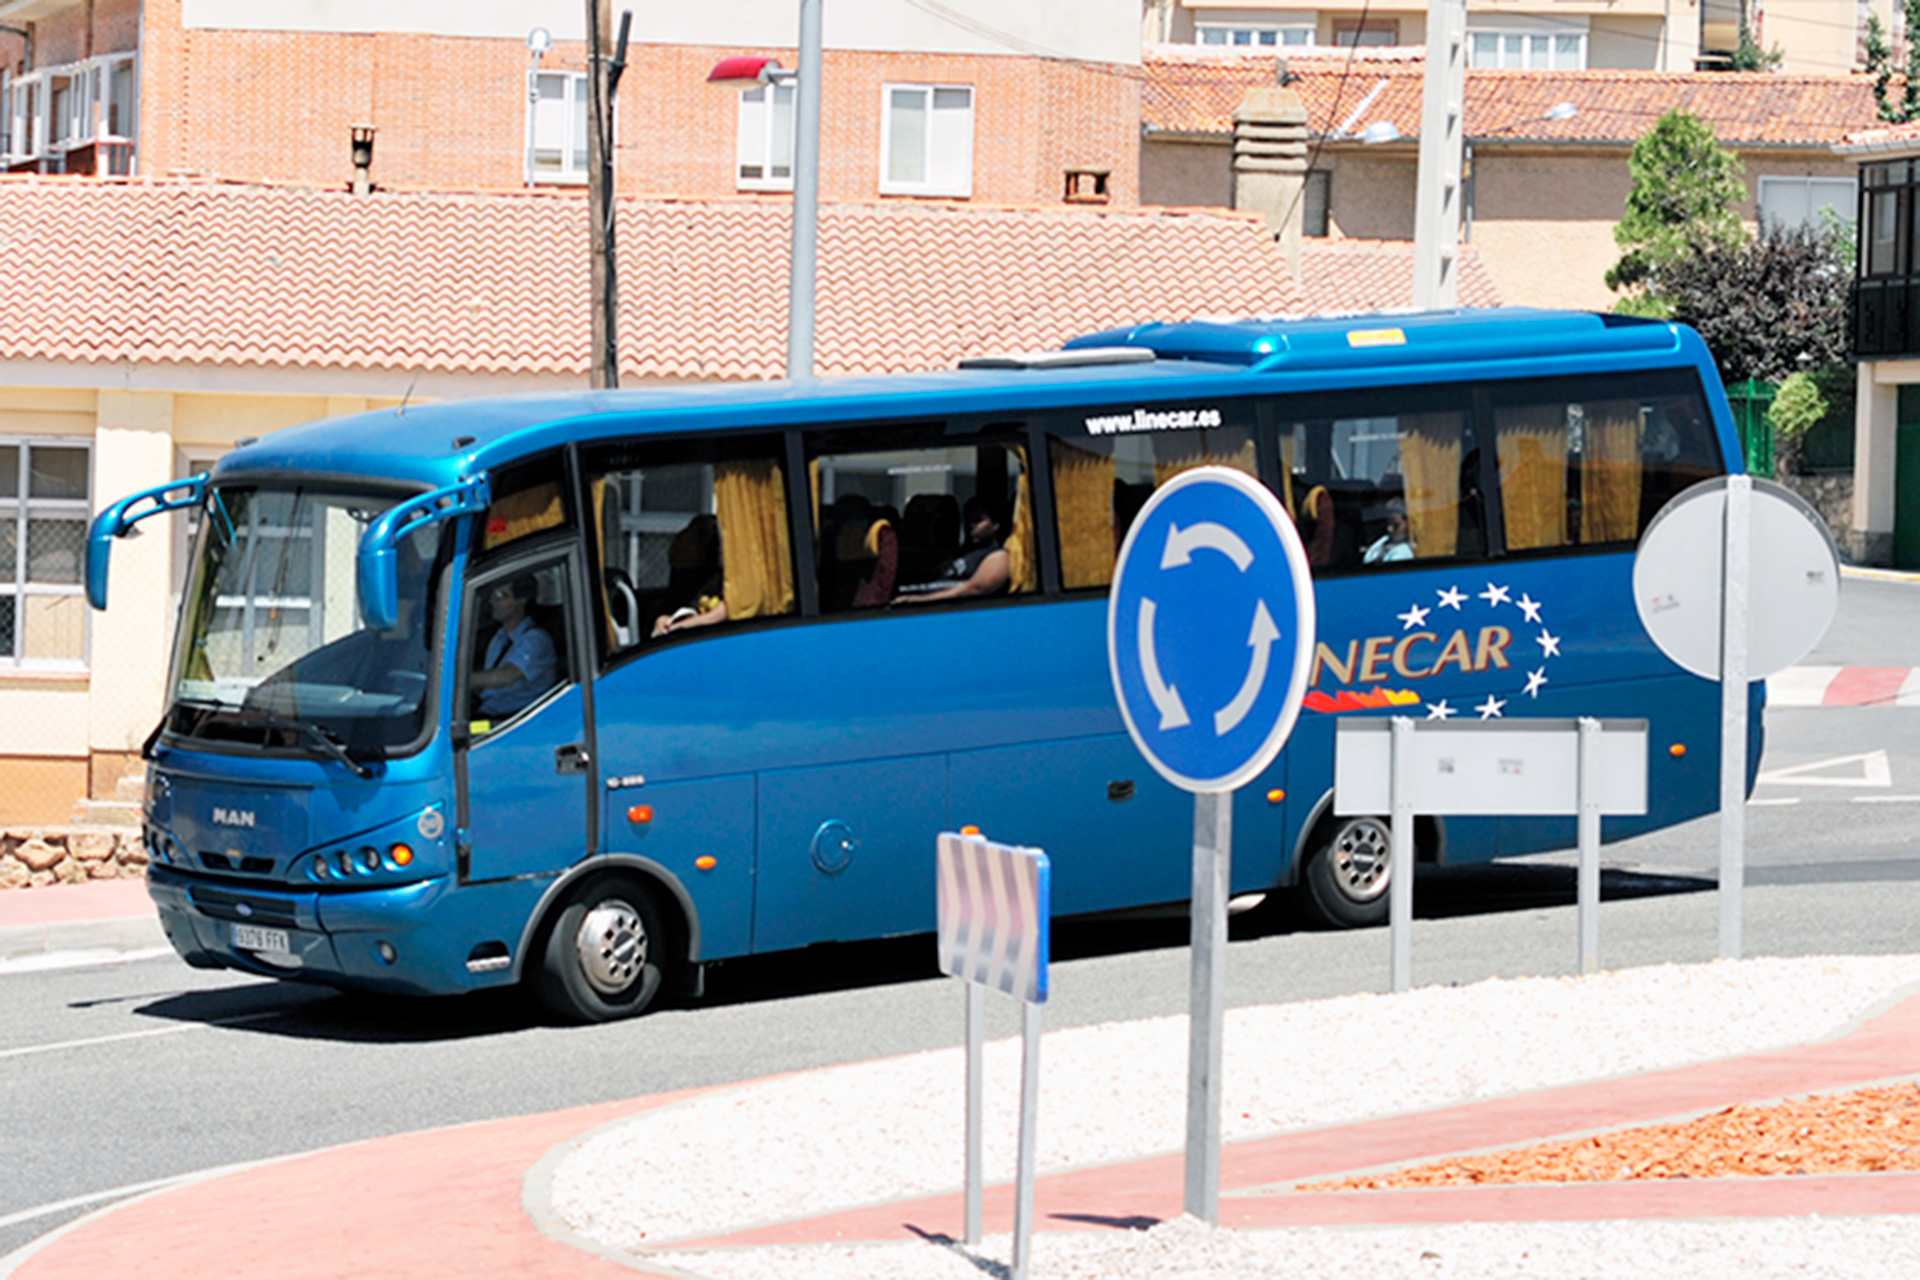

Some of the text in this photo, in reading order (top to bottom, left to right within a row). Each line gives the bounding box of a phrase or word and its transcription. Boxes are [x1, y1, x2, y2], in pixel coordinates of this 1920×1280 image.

[1085, 409, 1222, 435] www.linecar.es
[1308, 625, 1513, 688] NECAR
[213, 807, 255, 827] MAN
